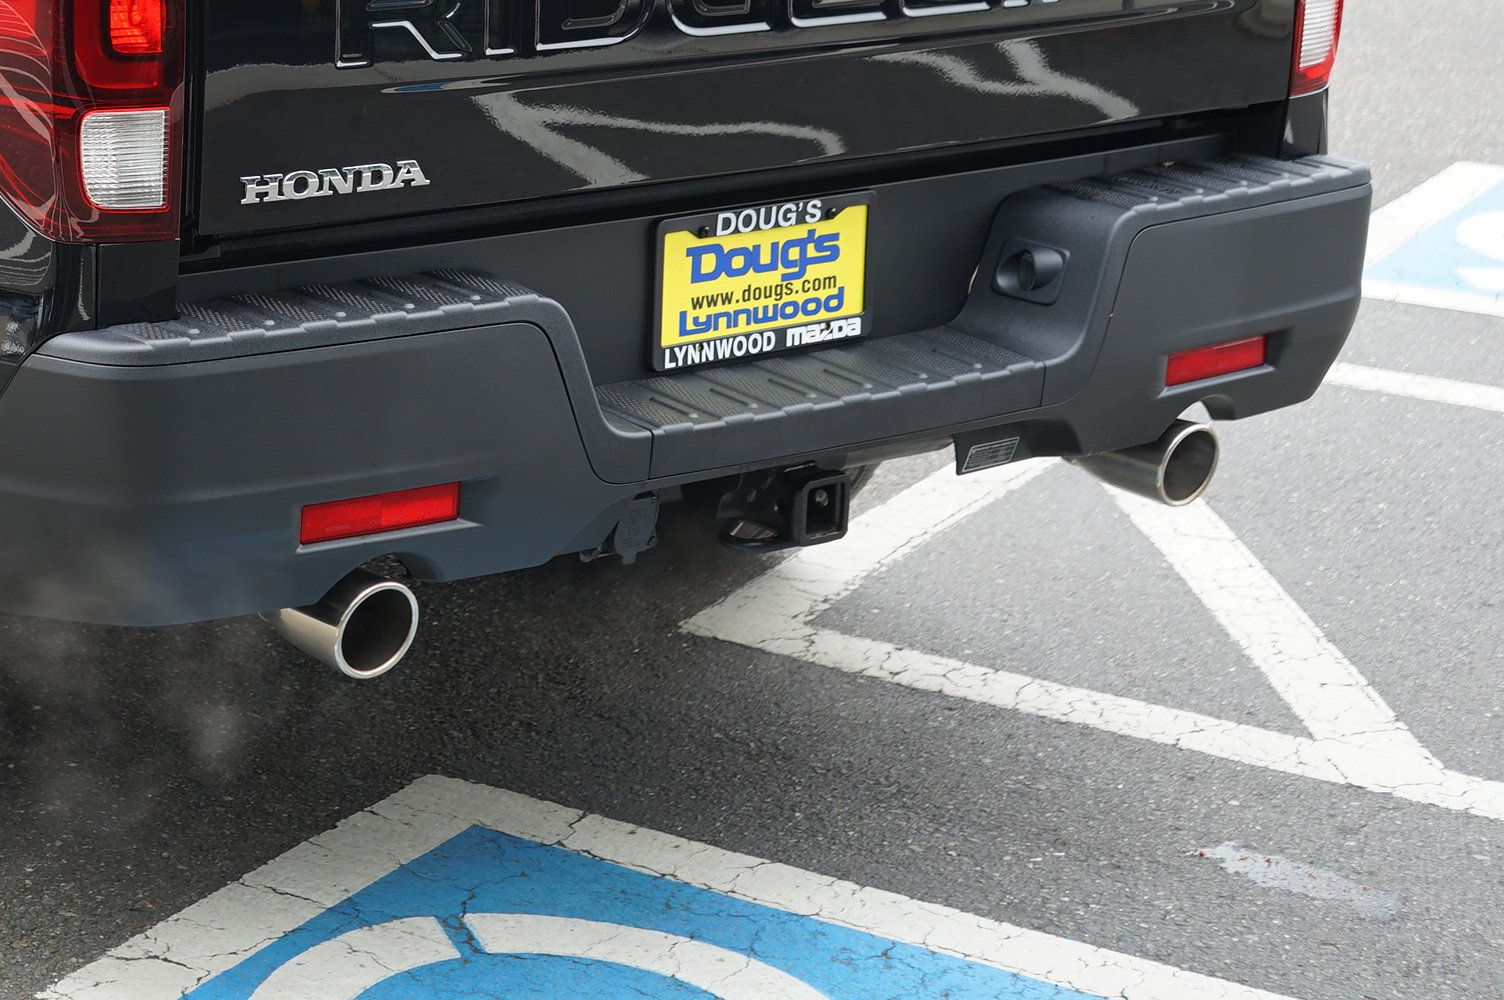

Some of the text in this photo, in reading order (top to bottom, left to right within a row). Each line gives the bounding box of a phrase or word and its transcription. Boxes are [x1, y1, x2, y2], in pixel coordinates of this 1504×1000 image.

[240, 159, 431, 205] HONDA
[715, 199, 823, 237] DOUG'S
[686, 229, 841, 284] Doug's
[678, 286, 845, 338] Lynnwood
[691, 275, 838, 310] www.dougs.com
[664, 330, 776, 369] LYNNWOOD
